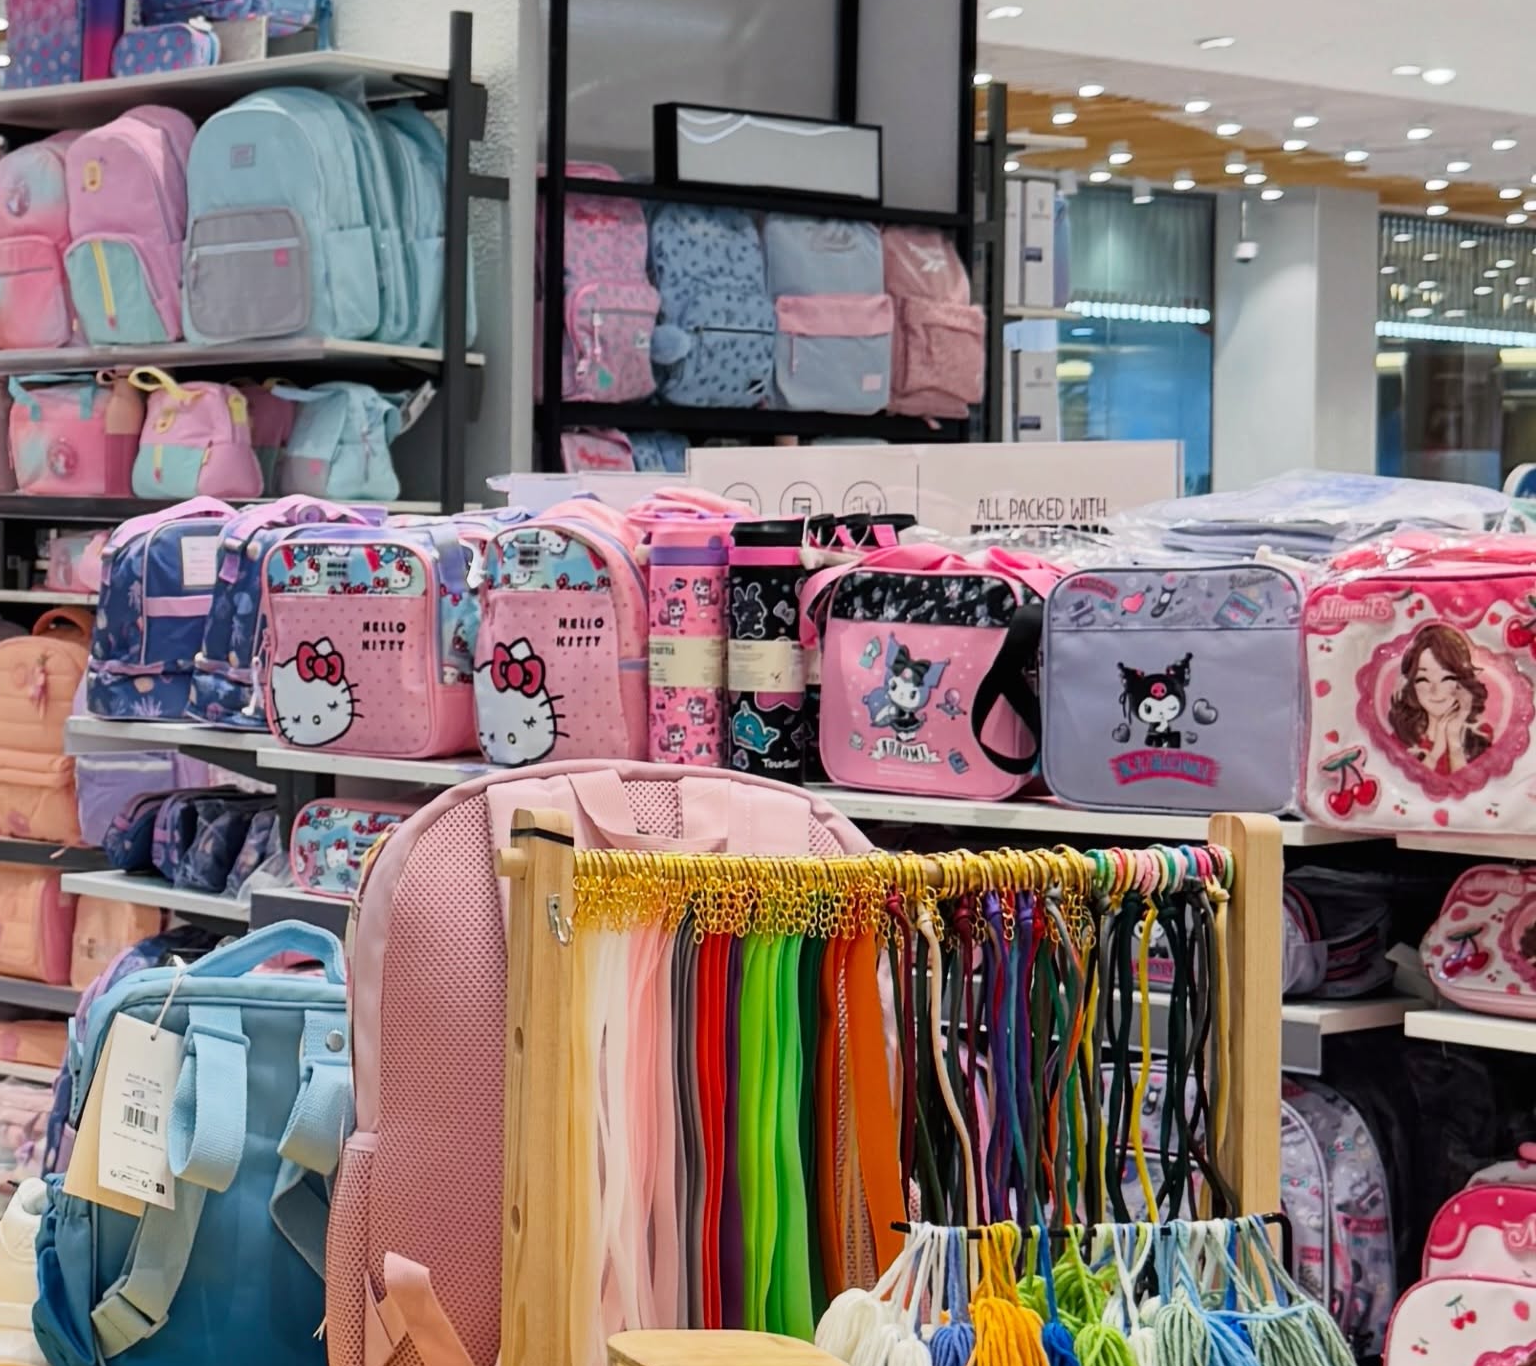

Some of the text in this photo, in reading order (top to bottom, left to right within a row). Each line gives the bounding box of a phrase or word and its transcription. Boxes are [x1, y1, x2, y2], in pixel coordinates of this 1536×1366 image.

[976, 497, 1108, 521] ALL PACKED WITH
[362, 620, 407, 634] HELLO
[557, 616, 606, 631] HELLO
[361, 638, 405, 652] KITTY
[555, 635, 602, 649] KITTY
